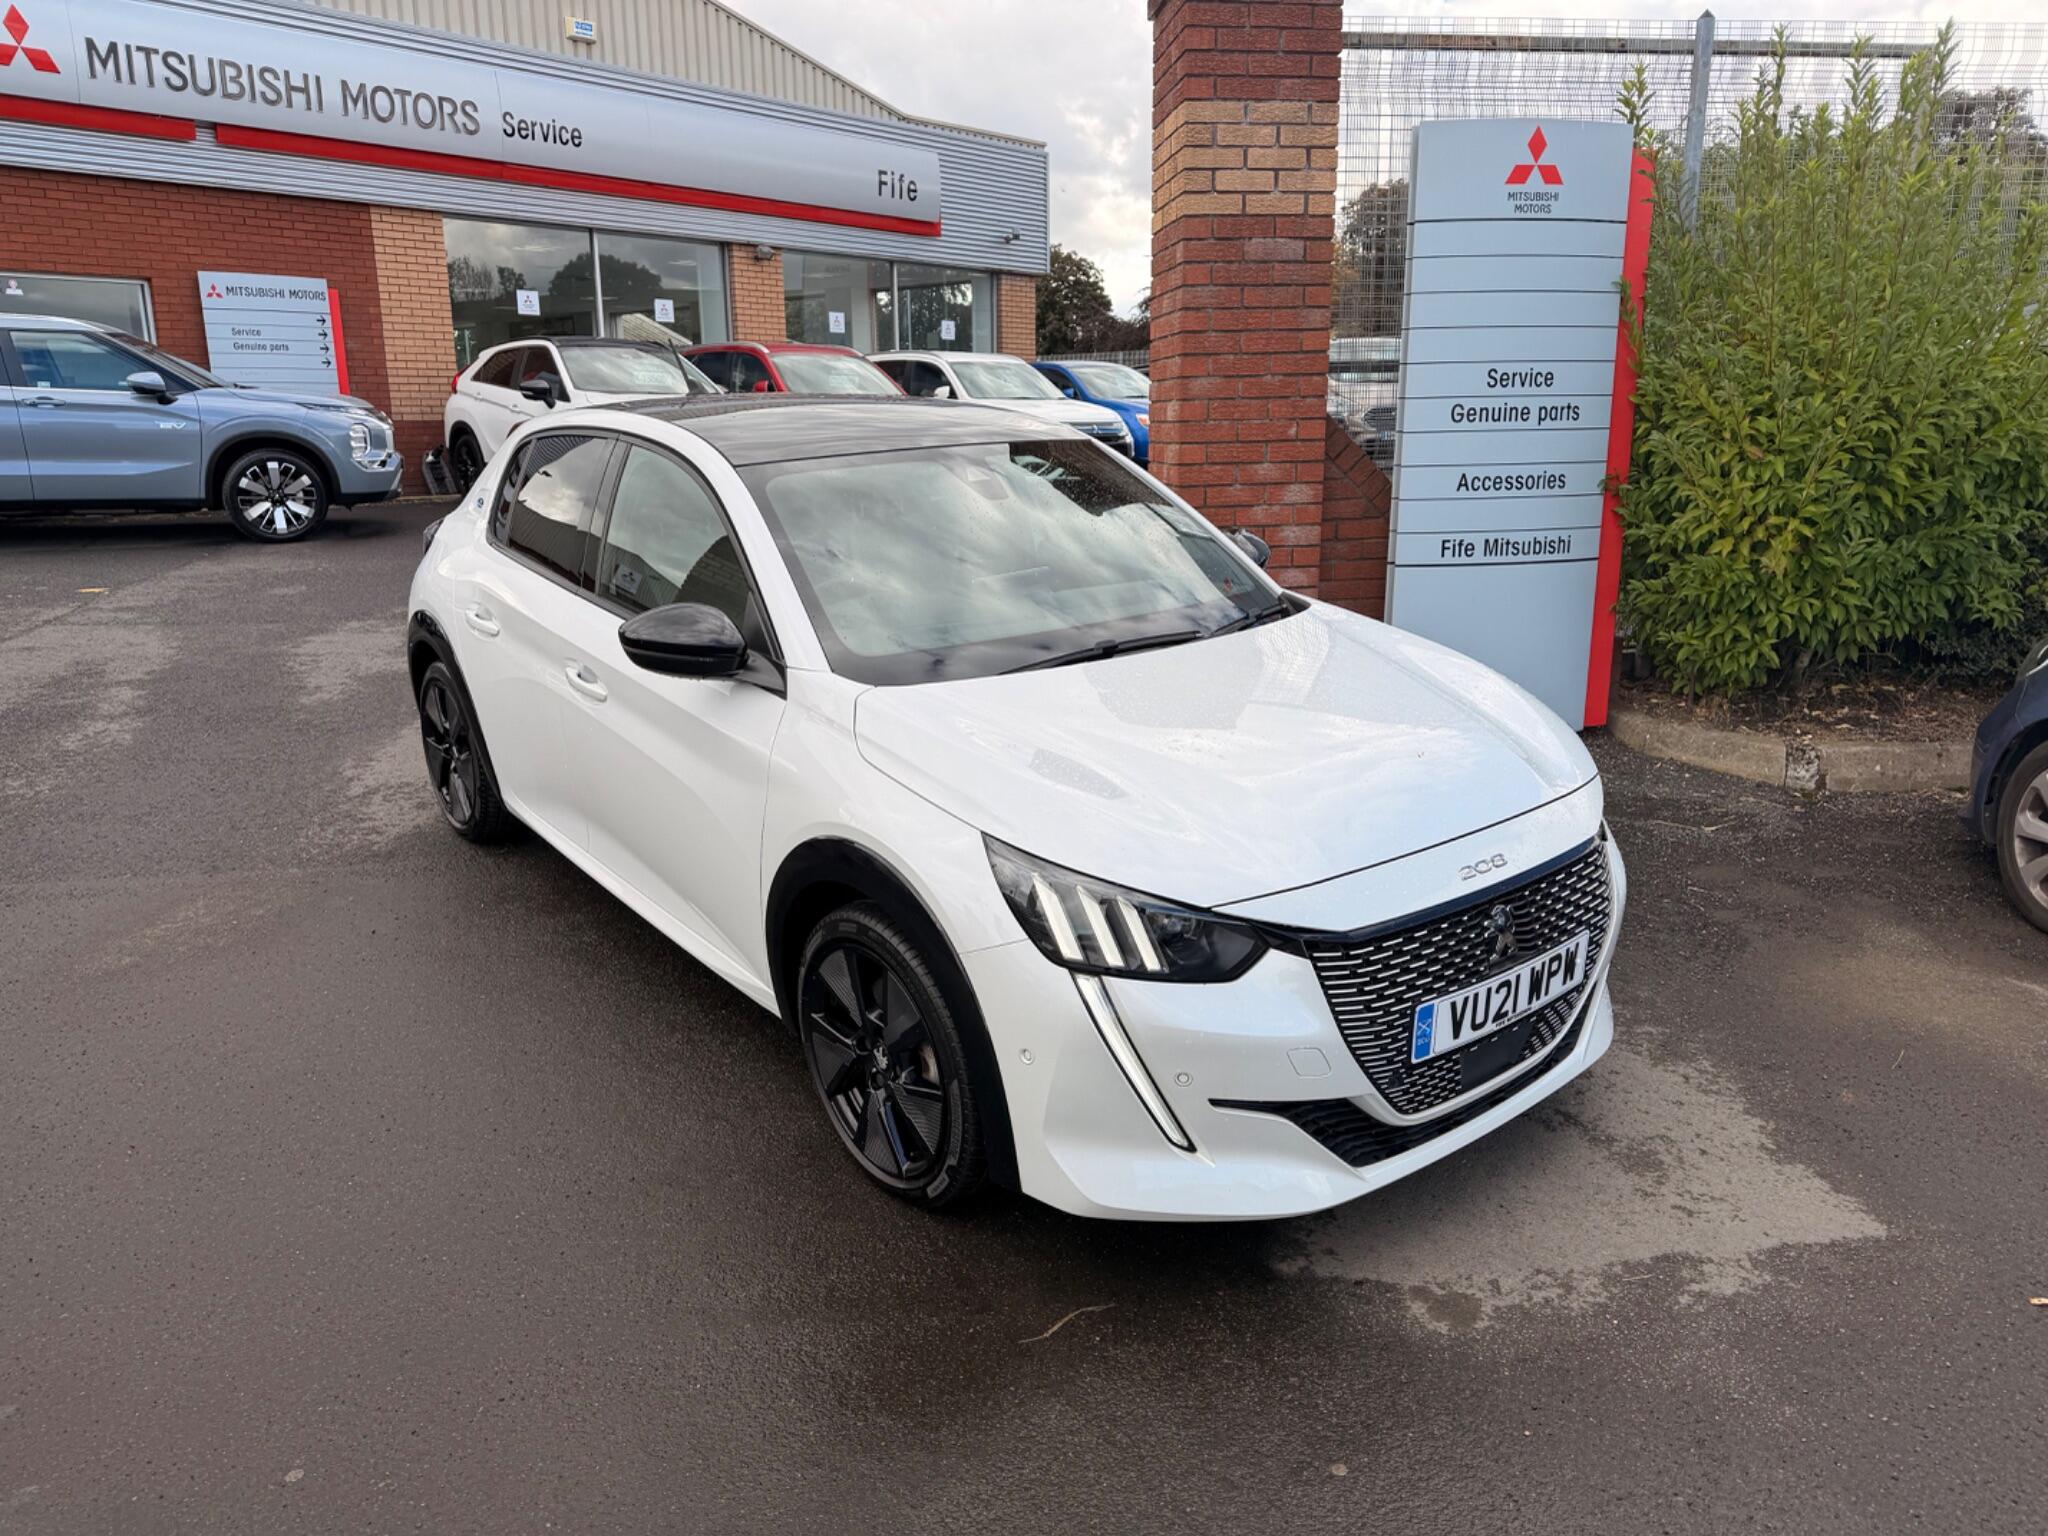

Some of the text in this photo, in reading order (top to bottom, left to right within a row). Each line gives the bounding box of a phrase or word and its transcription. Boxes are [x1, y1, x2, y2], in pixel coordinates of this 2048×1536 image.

[85, 37, 481, 136] MITSUBISHI MOTORS
[502, 111, 583, 148] Service
[878, 169, 918, 202] Fife
[1507, 191, 1559, 202] MITSUBISHI
[1514, 203, 1552, 214] MOTORS
[225, 286, 326, 301] MITSUBISHI MOTORS
[231, 327, 262, 337] Service
[233, 342, 289, 352] Genuine parts
[1486, 367, 1554, 389] Service
[1450, 402, 1580, 426] Genuine parts
[1456, 470, 1567, 493] Accessories
[1440, 534, 1572, 558] Fife Mitsubishi
[1458, 852, 1509, 881] 208
[1450, 942, 1580, 1041] VU21 WPW
